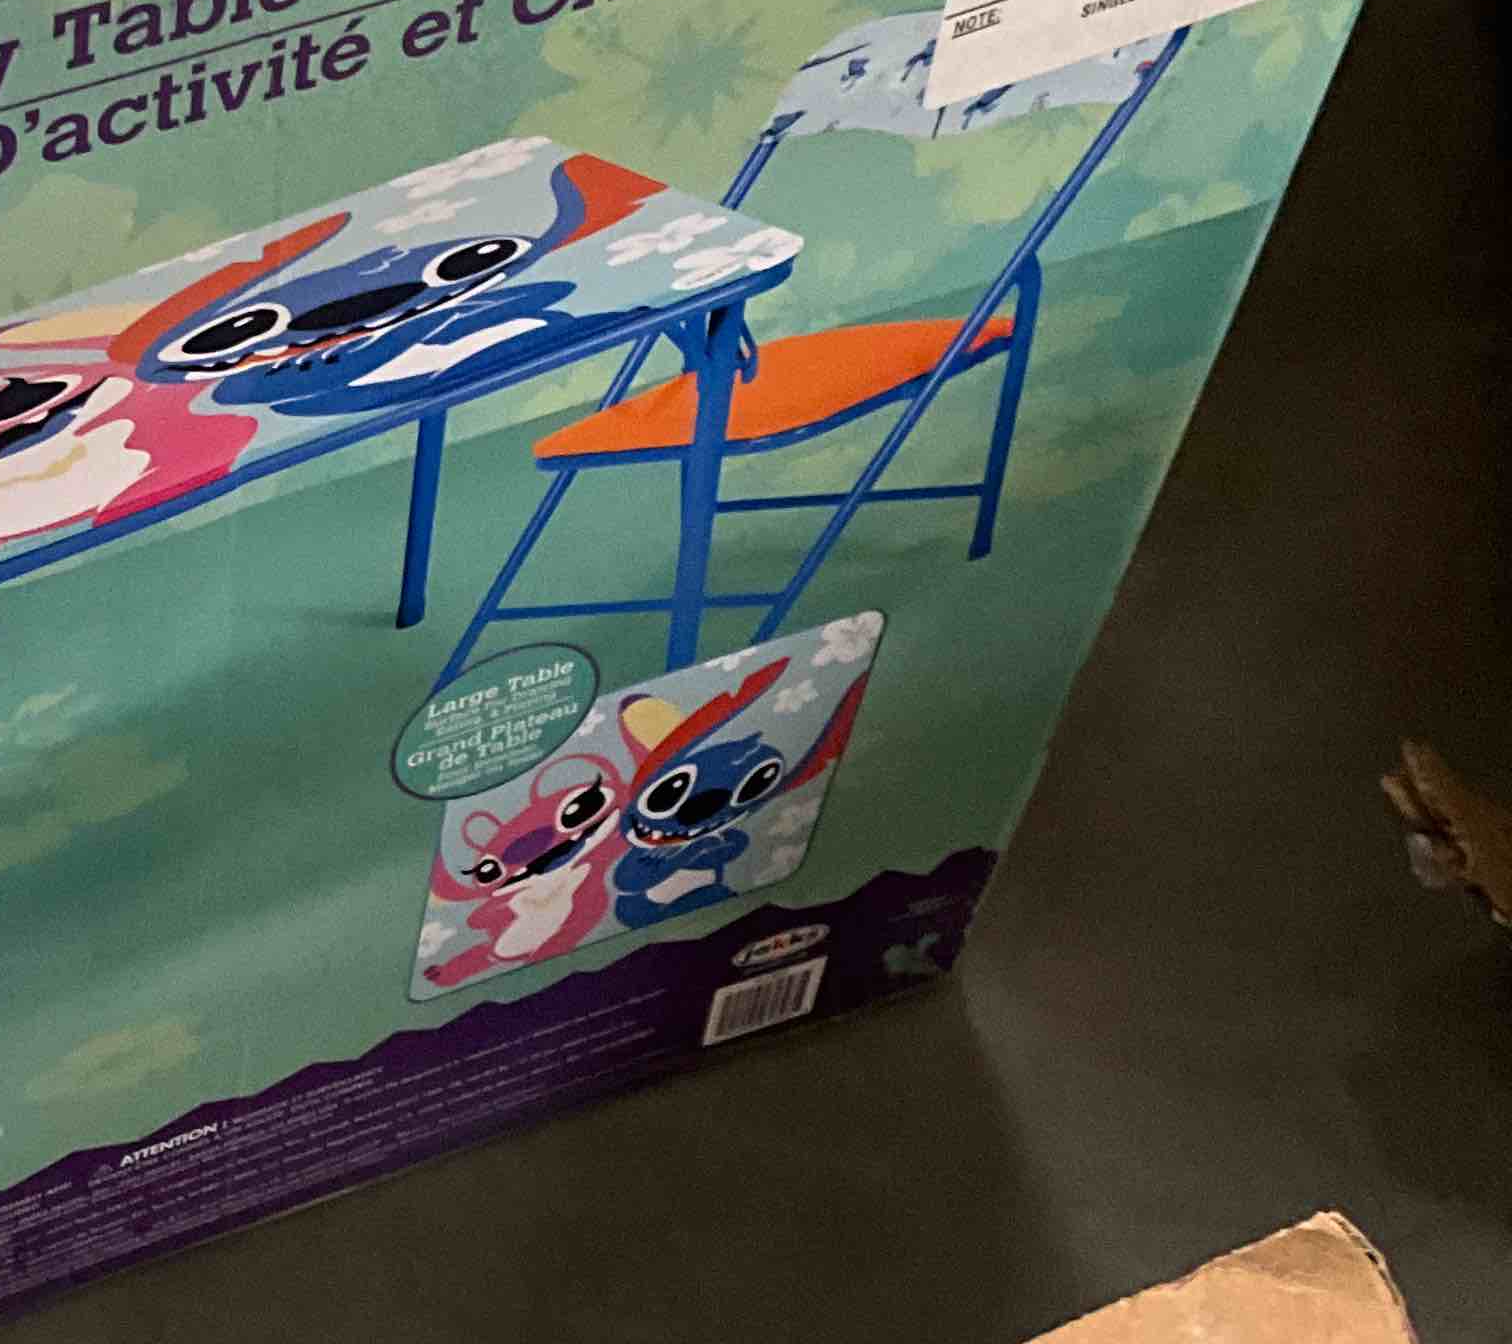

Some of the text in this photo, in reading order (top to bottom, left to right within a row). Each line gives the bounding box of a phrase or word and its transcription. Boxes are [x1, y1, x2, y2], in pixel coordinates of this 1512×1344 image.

[953, 7, 1002, 36] NOTE:
[427, 685, 500, 720] Large
[508, 661, 576, 694] Table
[407, 730, 483, 770] Grand
[490, 703, 580, 741] Plateau
[439, 750, 469, 772] de
[476, 727, 544, 758] Table
[120, 1122, 218, 1168] ATTENTION
